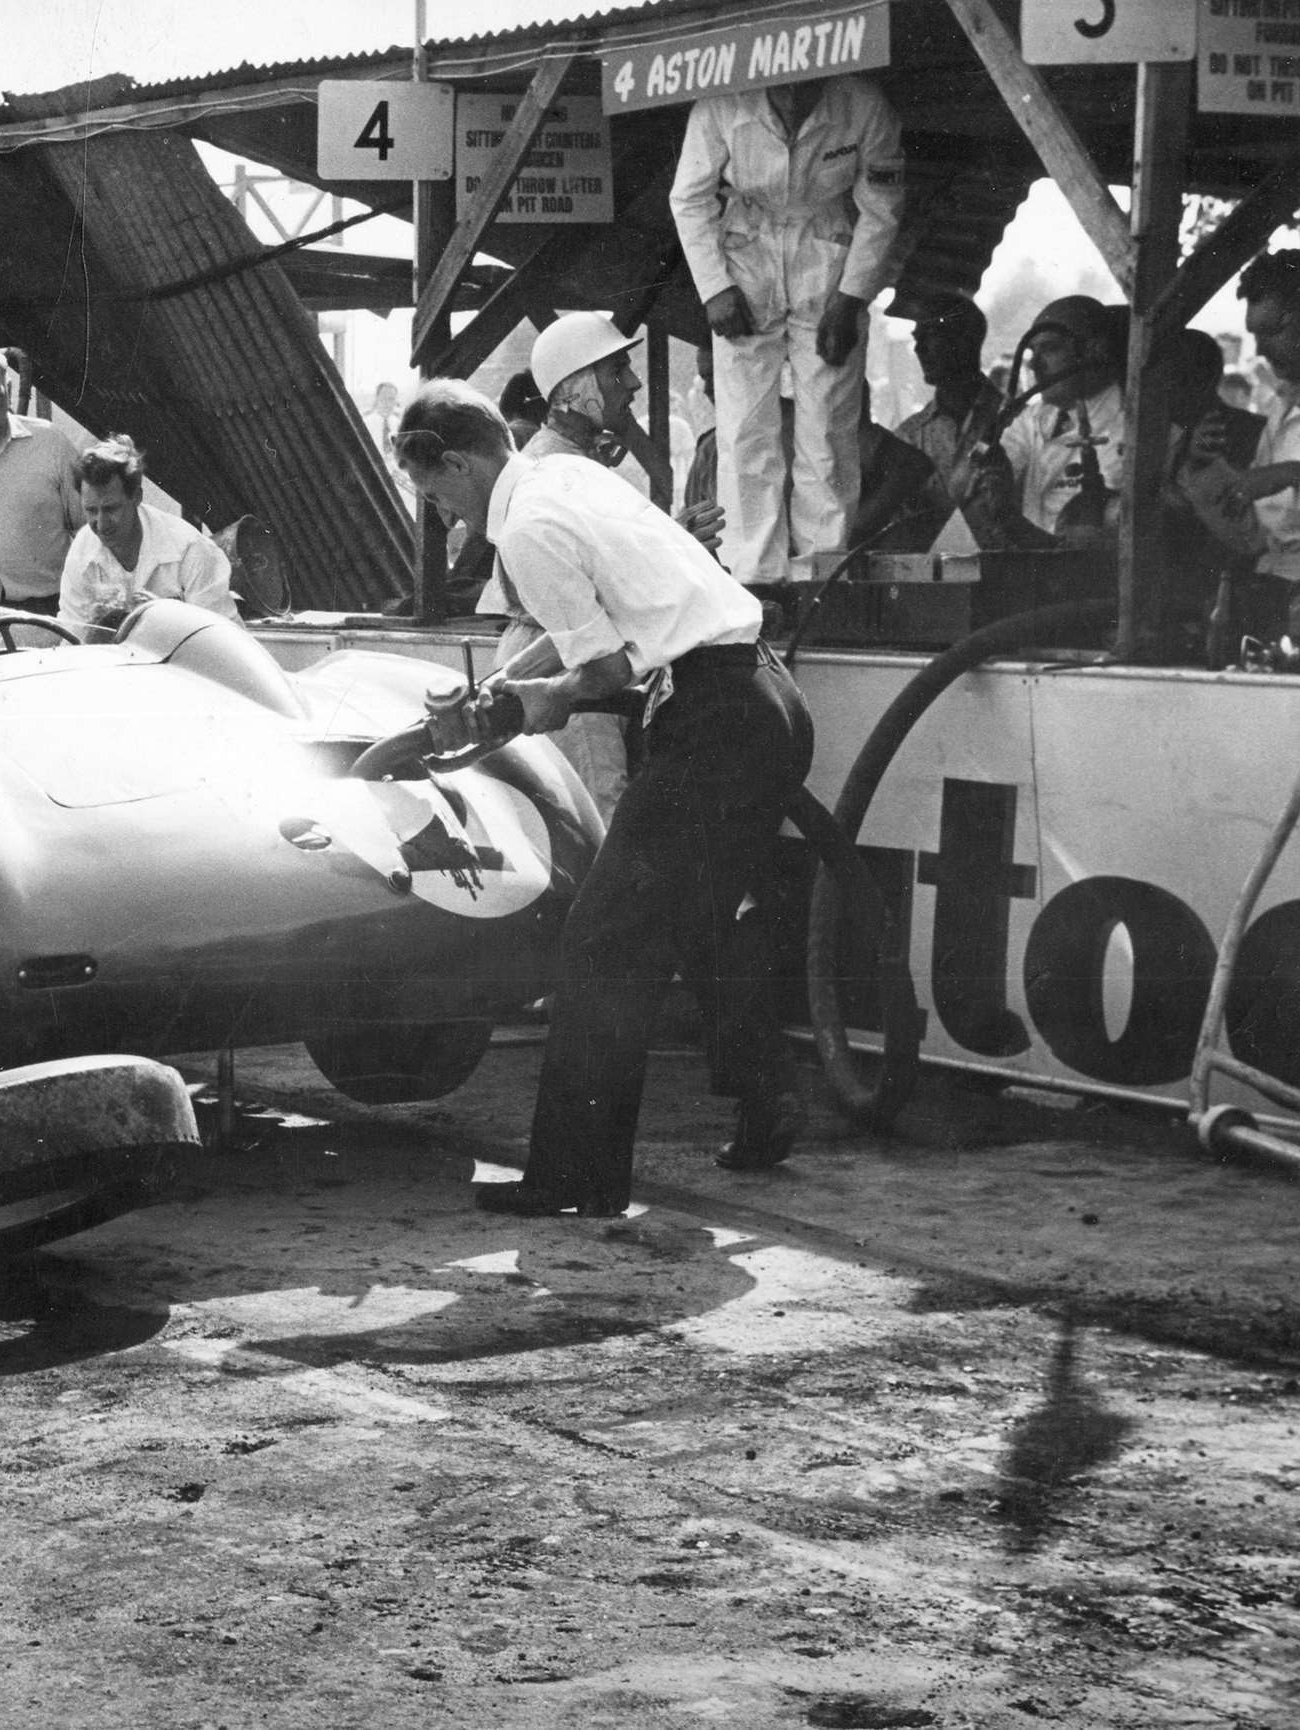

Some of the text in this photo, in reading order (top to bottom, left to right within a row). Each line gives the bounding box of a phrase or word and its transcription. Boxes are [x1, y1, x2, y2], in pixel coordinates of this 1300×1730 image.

[614, 15, 865, 102] 4 ASTON MARTIN
[1271, 81, 1294, 103] PIT
[353, 101, 394, 160] 4
[516, 177, 556, 193] THROW
[518, 196, 536, 213] PIT
[541, 196, 573, 213] ROAD
